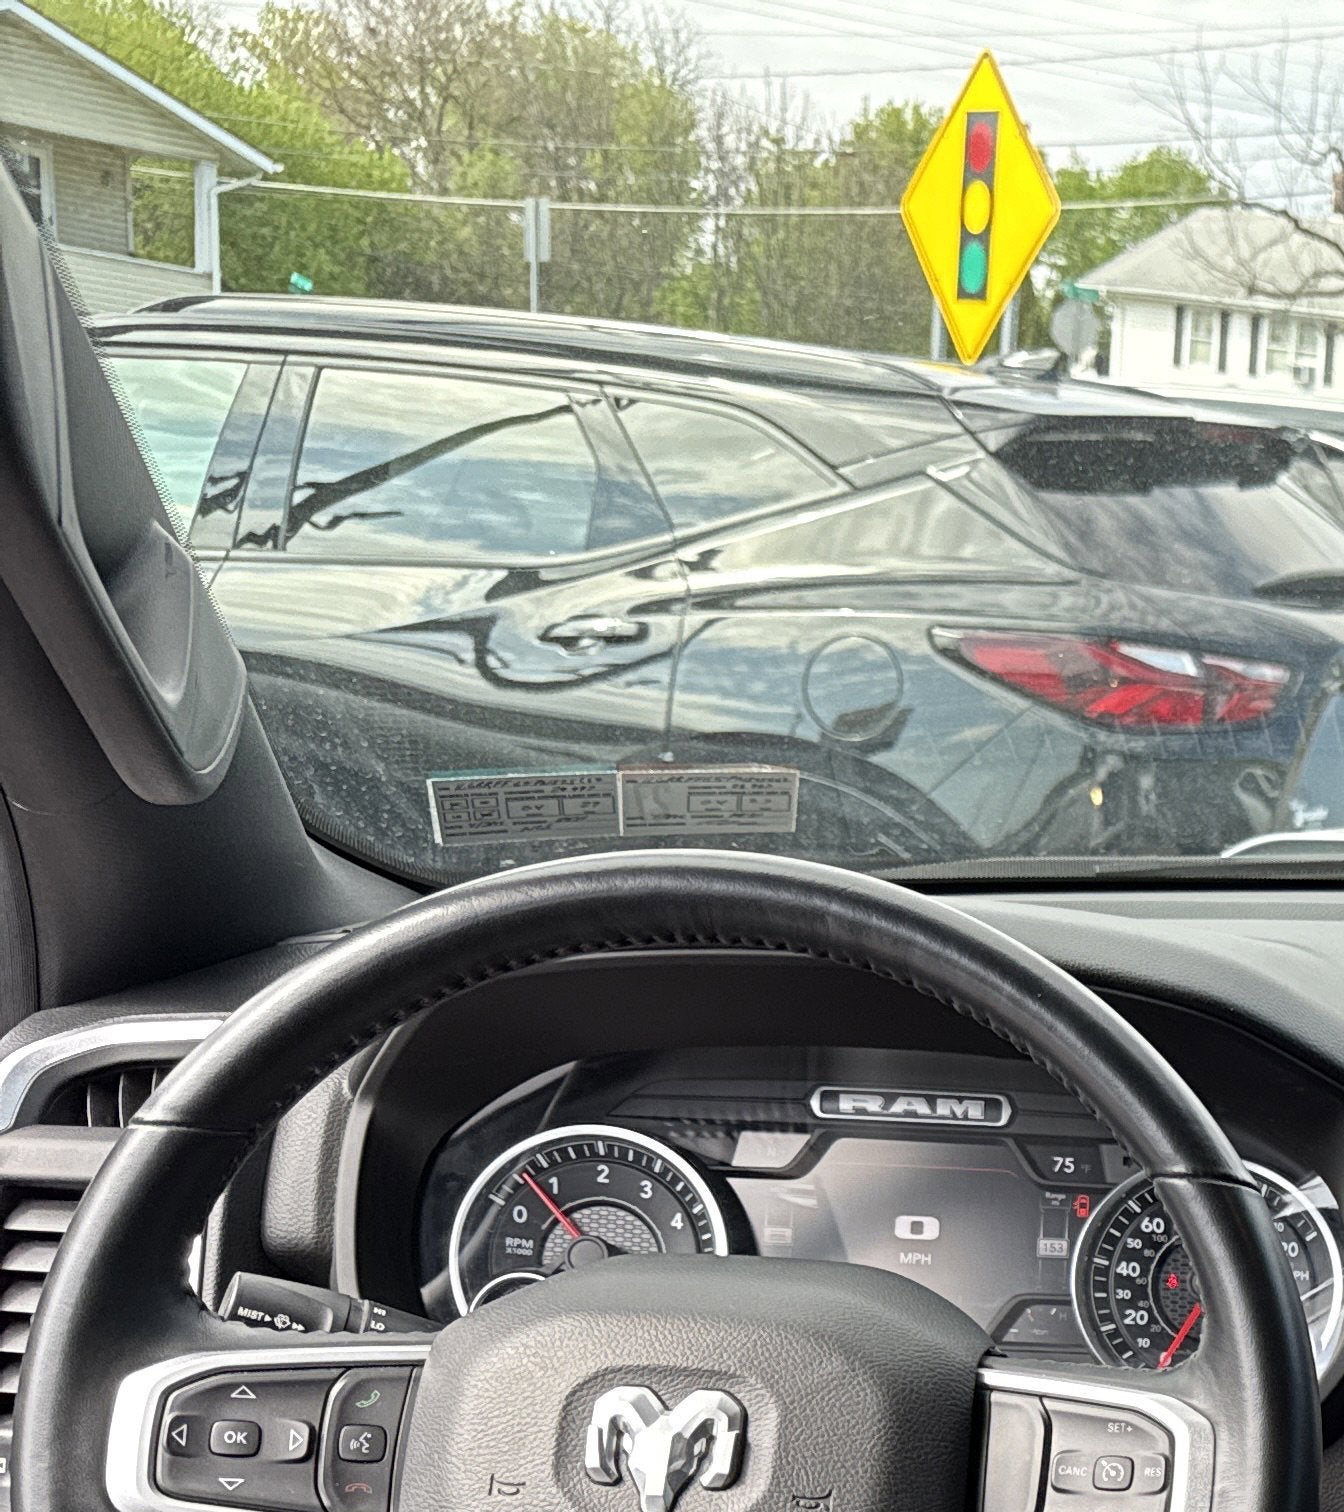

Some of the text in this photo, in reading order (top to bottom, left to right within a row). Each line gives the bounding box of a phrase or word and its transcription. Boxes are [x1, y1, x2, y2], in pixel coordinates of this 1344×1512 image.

[839, 1094, 985, 1119] RAM
[1053, 1157, 1075, 1173] 75
[596, 1165, 610, 1184] 2
[548, 1177, 559, 1195] 1
[639, 1180, 653, 1199] 3
[512, 1205, 528, 1223] 0
[670, 1212, 684, 1230] 4
[1141, 1217, 1165, 1234] 60
[505, 1236, 534, 1248] RPM
[1043, 1243, 1064, 1253] 153
[1126, 1238, 1143, 1249] 50
[900, 1252, 932, 1265] MPH
[1116, 1261, 1141, 1277] 40
[1116, 1289, 1132, 1300] 30
[237, 1306, 265, 1322] MIST
[1123, 1310, 1149, 1326] 20
[370, 1320, 386, 1331] LO
[1137, 1338, 1150, 1349] 10
[223, 1430, 248, 1445] OK
[1058, 1465, 1088, 1477] CANC
[1144, 1467, 1162, 1477] RES
